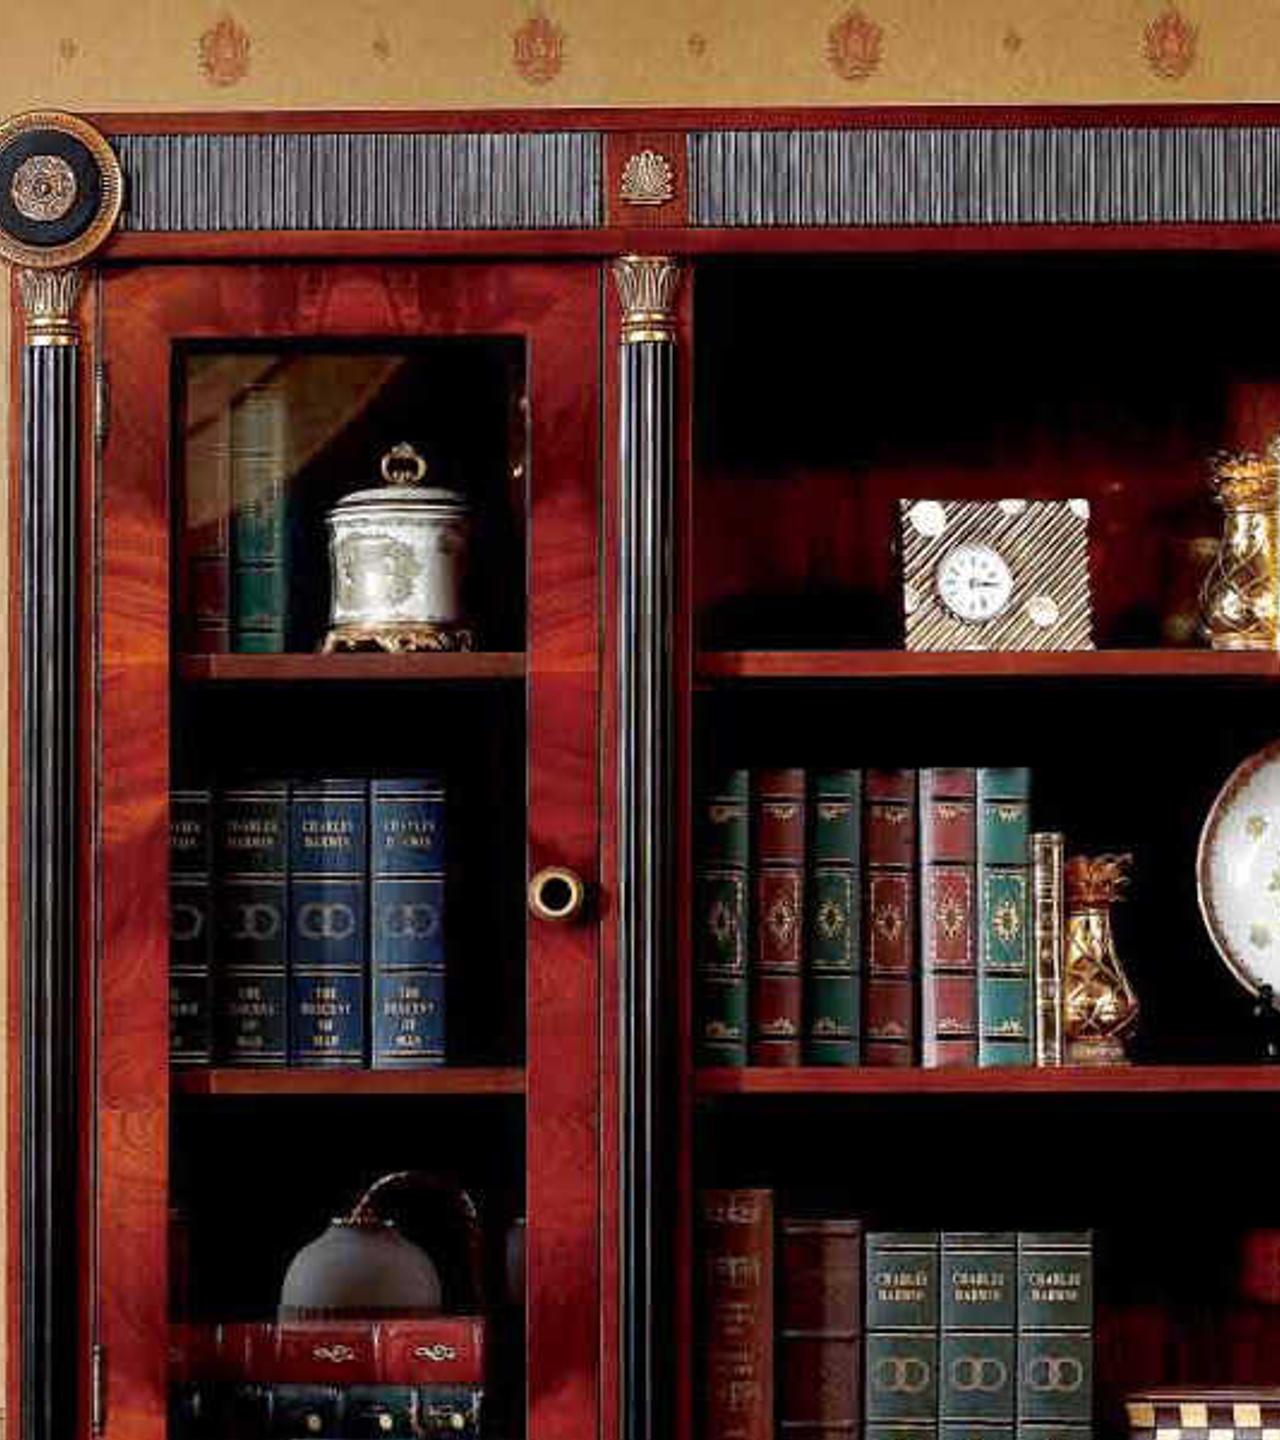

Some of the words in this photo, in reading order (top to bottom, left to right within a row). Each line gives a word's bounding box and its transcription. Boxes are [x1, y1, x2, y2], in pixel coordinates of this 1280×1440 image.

[876, 1271, 927, 1286] CHARLES
[952, 1271, 1004, 1286] CHARLES
[1029, 1271, 1080, 1286] CHARLES
